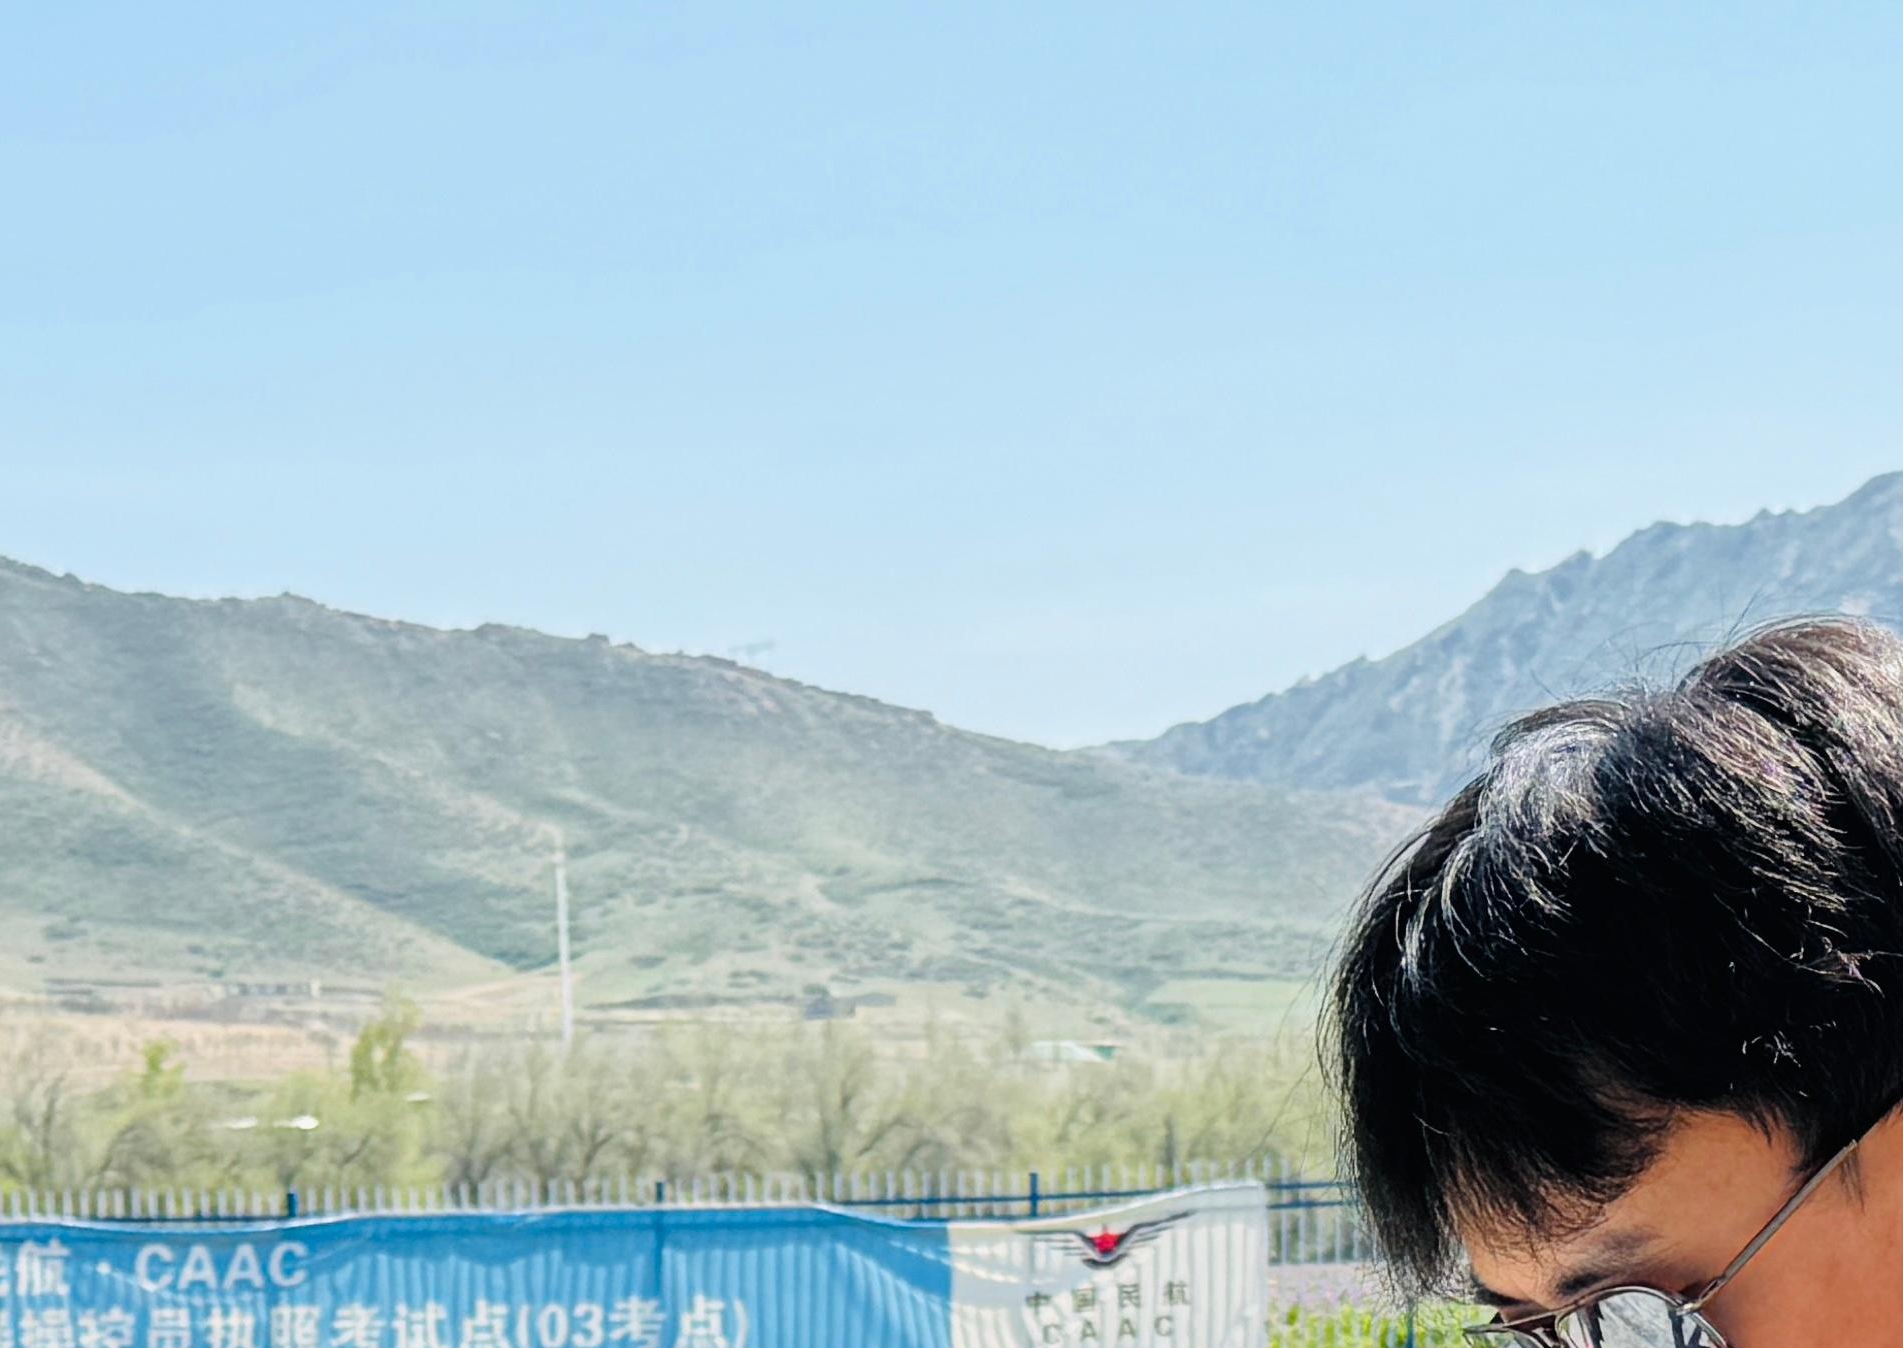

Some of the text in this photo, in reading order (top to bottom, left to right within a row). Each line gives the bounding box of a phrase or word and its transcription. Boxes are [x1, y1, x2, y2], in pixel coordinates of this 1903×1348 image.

[1025, 1281, 1190, 1313] 中国民航
[1043, 1315, 1174, 1345] CAAC
